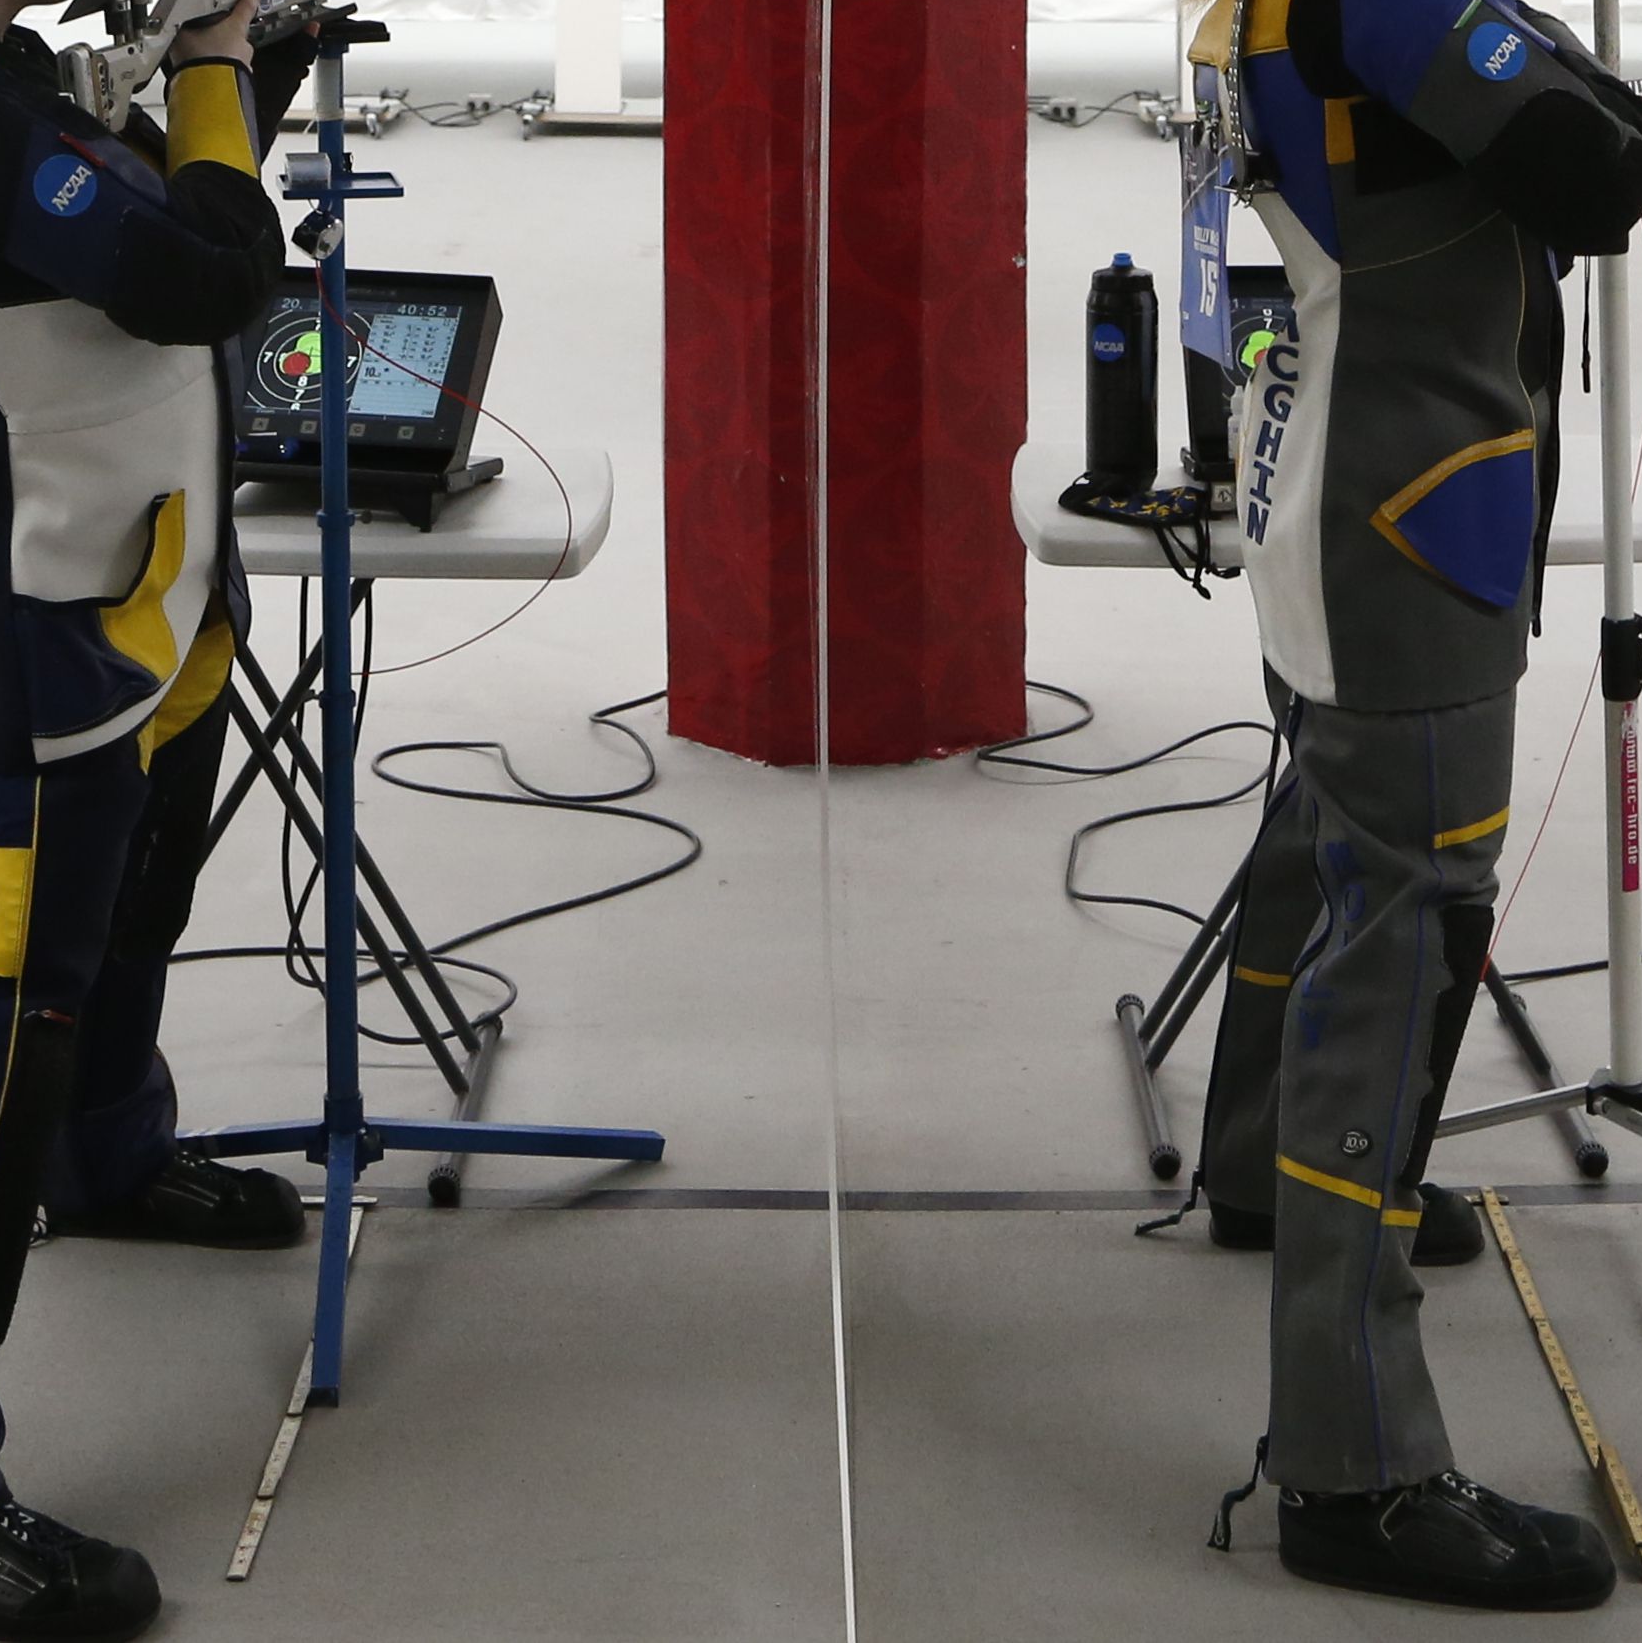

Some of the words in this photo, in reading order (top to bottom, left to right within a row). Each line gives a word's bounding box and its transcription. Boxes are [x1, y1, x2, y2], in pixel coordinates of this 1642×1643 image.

[1485, 33, 1521, 75] NCAA
[51, 164, 92, 212] NCAA
[397, 304, 448, 317] 40:52
[1093, 341, 1125, 353] NCAA
